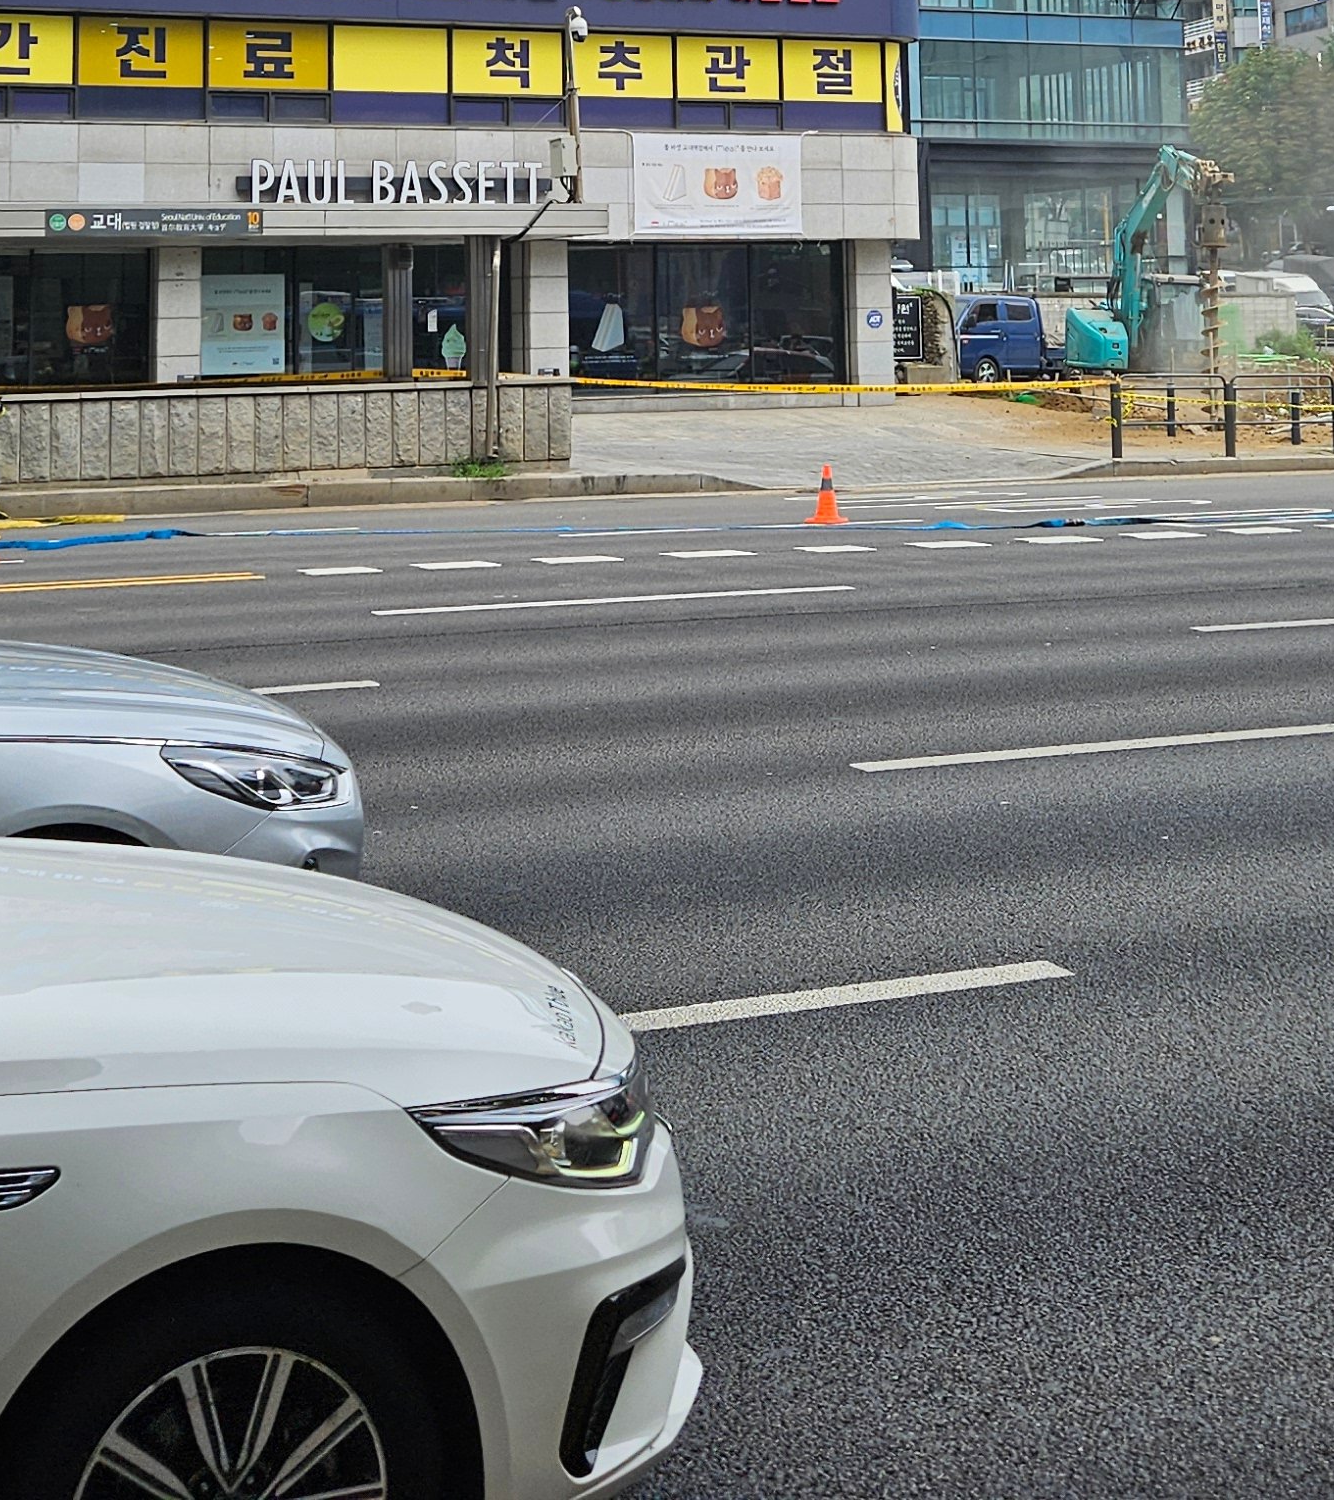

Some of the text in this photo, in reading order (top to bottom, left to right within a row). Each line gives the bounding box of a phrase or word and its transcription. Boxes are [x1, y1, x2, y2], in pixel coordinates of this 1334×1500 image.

[250, 158, 544, 205] PAUL BASSETT
[90, 212, 122, 231] 교대
[246, 211, 261, 225] 10
